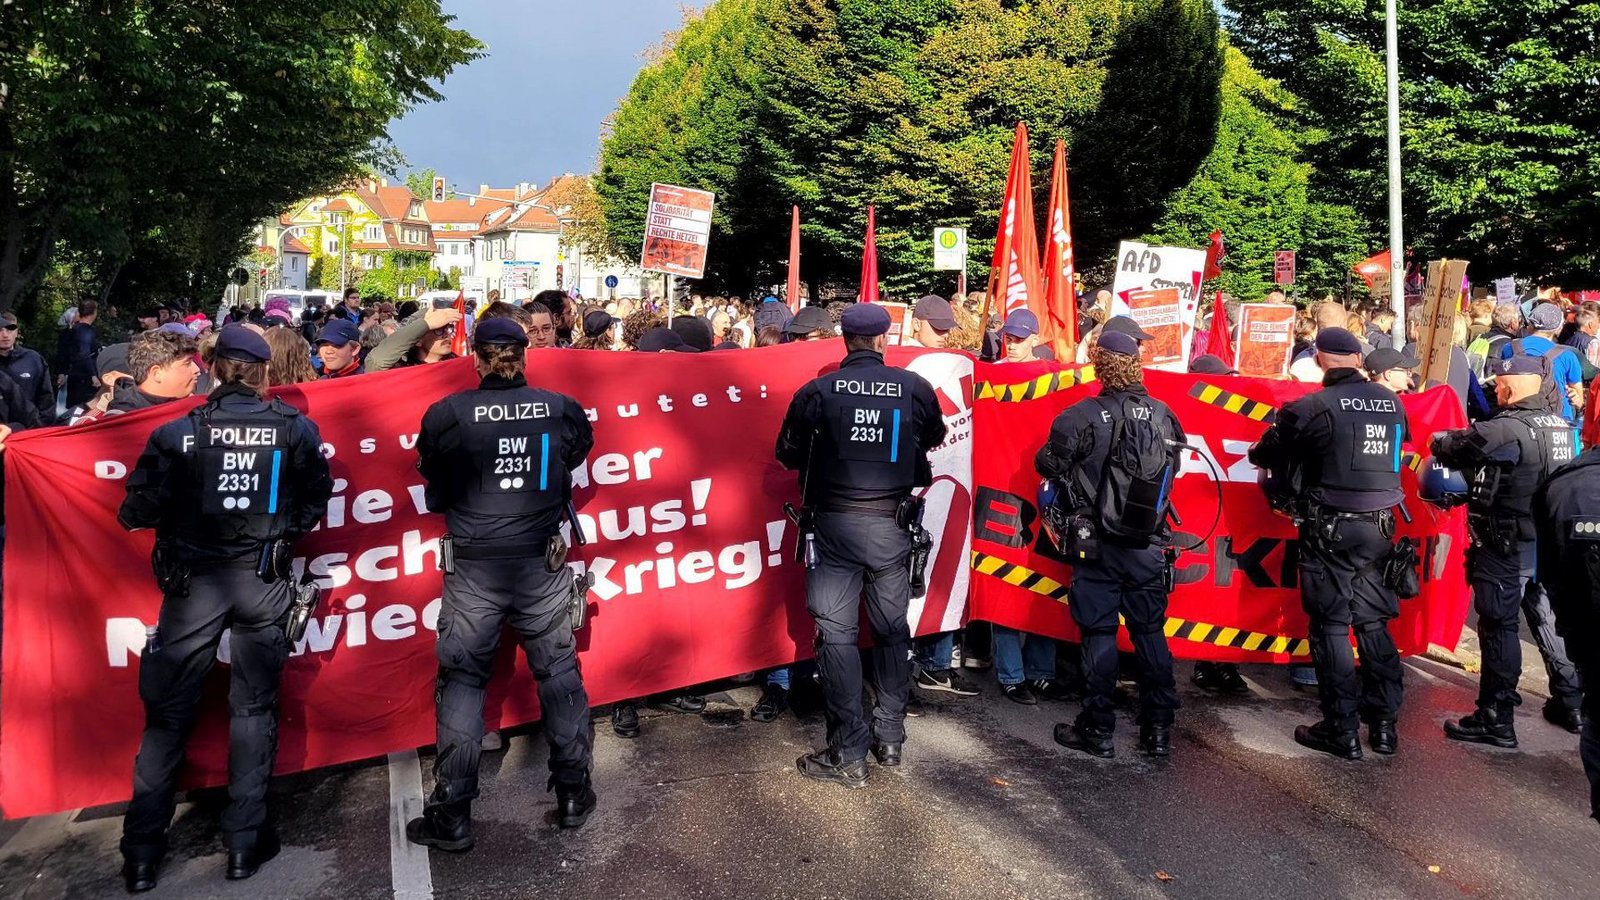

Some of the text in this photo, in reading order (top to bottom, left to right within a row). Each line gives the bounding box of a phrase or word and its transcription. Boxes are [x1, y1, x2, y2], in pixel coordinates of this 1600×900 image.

[654, 204, 693, 218] SOLIDARITÄT
[652, 215, 673, 226] STATT
[650, 227, 676, 239] RECHTE
[944, 234, 953, 245] H
[1121, 250, 1162, 274] AfD
[835, 380, 902, 398] POLIZEI
[474, 402, 550, 422] POLIZEI
[1340, 398, 1397, 413] POLIZEI
[854, 408, 881, 425] BW
[210, 428, 278, 446] POLIZEI
[850, 426, 884, 443] 2331
[949, 430, 970, 445] der
[1365, 424, 1387, 439] BW
[1552, 431, 1568, 445] BW
[498, 437, 528, 456] BW
[1363, 440, 1389, 455] 2331
[1552, 447, 1572, 460] 2331
[223, 452, 257, 471] BW
[494, 456, 532, 474] 2331
[217, 474, 260, 492] 2331
